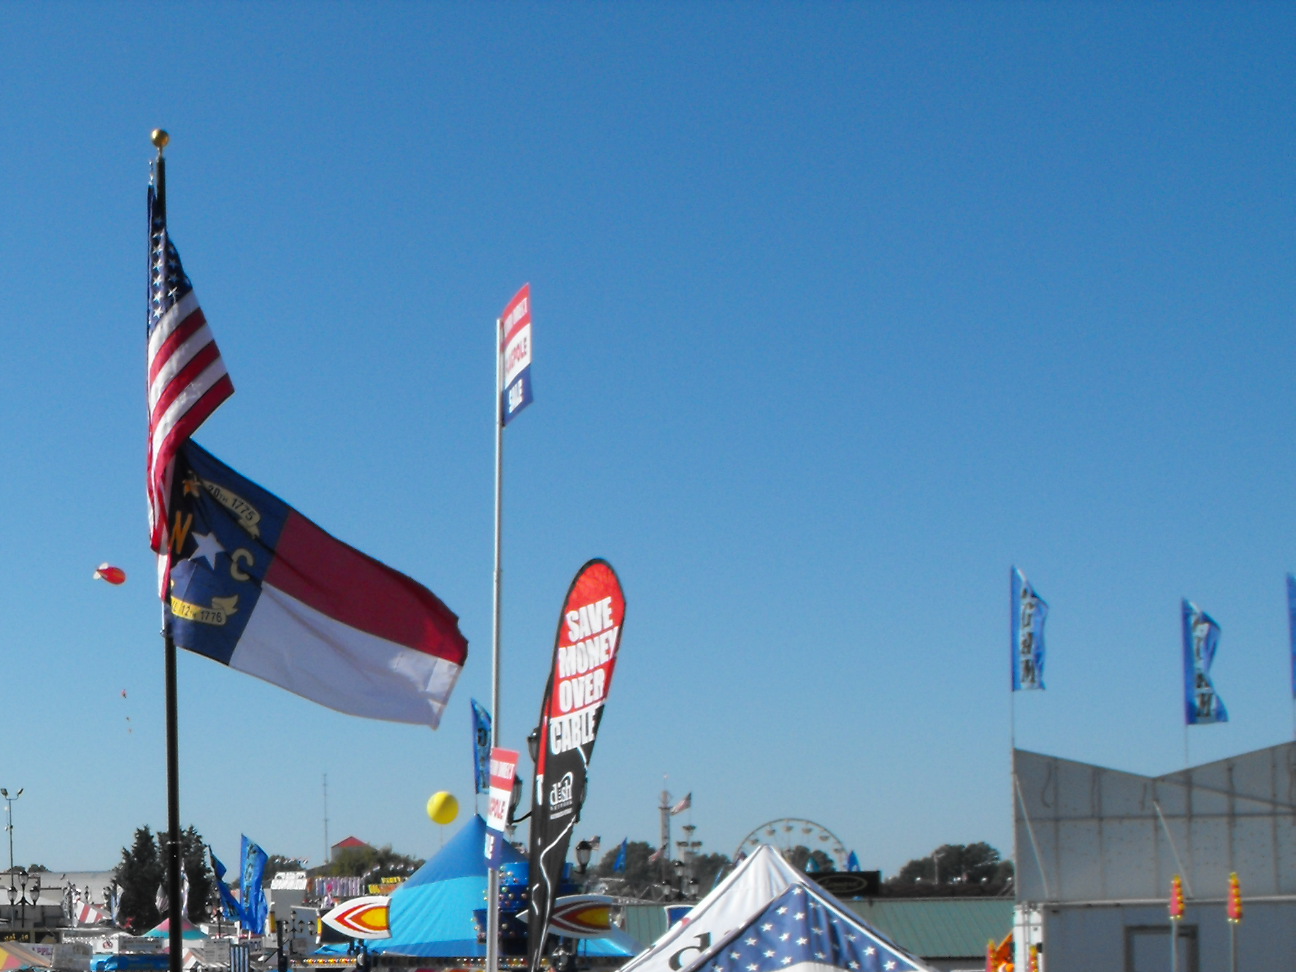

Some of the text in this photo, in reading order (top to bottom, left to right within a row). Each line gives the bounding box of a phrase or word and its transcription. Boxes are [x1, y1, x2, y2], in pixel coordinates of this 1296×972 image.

[231, 497, 255, 522] 1775
[168, 510, 254, 581] N C
[566, 596, 614, 642] SAVE
[558, 626, 619, 678] MONEY
[559, 668, 605, 713] OVER
[549, 704, 600, 755] CABLE
[550, 780, 573, 806] dish
